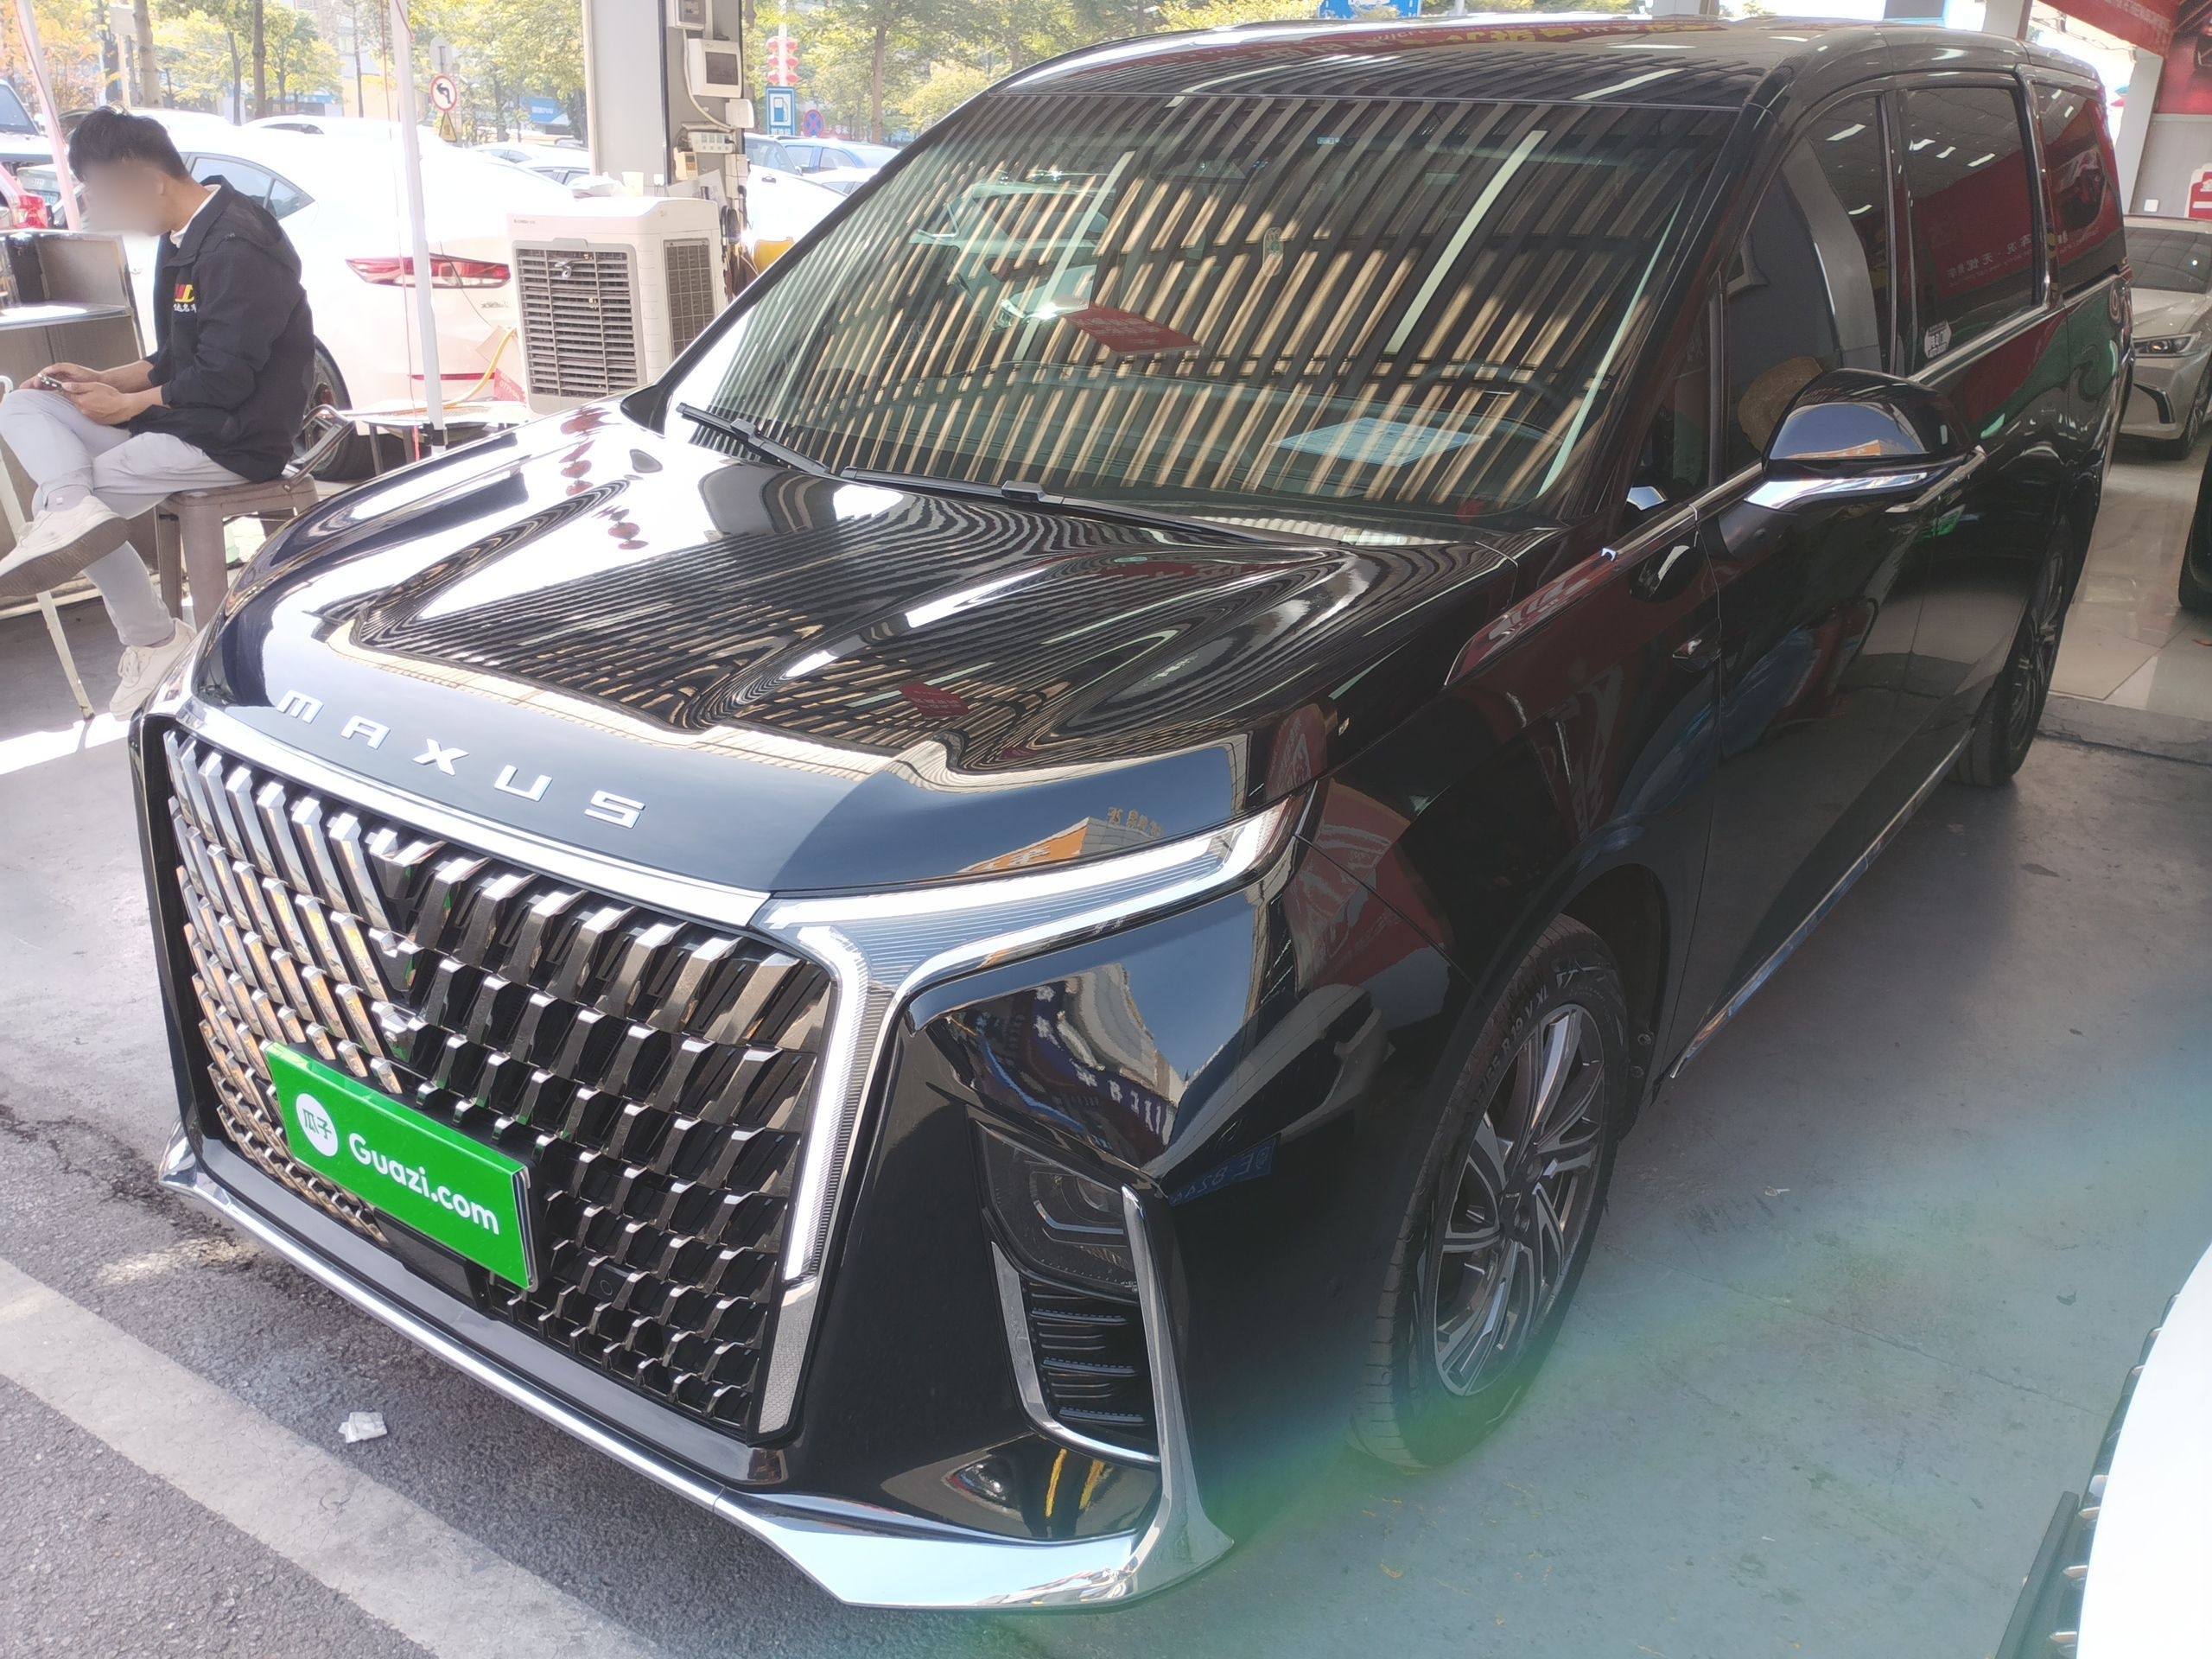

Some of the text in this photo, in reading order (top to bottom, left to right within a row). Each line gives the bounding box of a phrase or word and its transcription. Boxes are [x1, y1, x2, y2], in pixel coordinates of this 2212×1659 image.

[276, 689, 646, 829] MAXUS
[302, 1108, 500, 1235] 瓜子 Guazi.com
